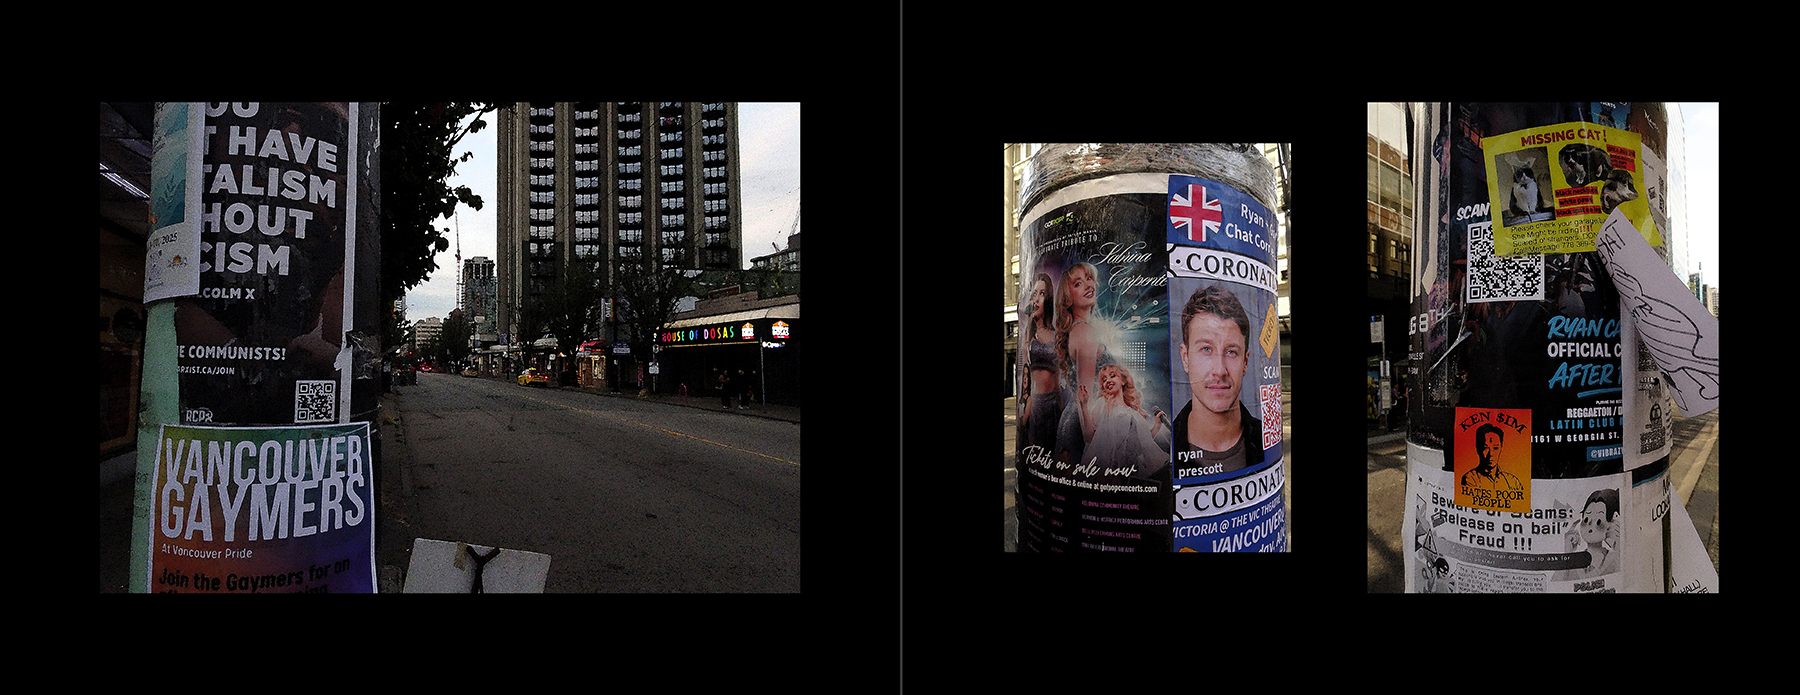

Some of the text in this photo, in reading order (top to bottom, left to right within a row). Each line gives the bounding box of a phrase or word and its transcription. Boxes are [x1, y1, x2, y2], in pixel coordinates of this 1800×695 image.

[1520, 133, 1575, 147] MISSING
[229, 126, 338, 173] HAVE
[1241, 203, 1264, 228] Ryan
[1456, 203, 1490, 221] SCAN
[1535, 221, 1555, 229] check
[1557, 219, 1572, 228] your
[1225, 222, 1254, 245] Chat
[1511, 233, 1526, 241] She
[1526, 229, 1546, 238] Might
[1512, 238, 1538, 247] Scared
[245, 288, 255, 300] X
[662, 331, 685, 342] HOUSE
[690, 329, 699, 341] OF
[703, 325, 735, 340] DOSAS
[1547, 315, 1604, 339] RYAN
[188, 345, 286, 360] COMMUNISTS!
[1547, 341, 1612, 358] OFFICIAL
[1547, 361, 1614, 389] AFTER
[1566, 406, 1612, 418] REGGAETON
[1459, 412, 1490, 432] KEN
[1550, 419, 1583, 430] LATIN
[1588, 417, 1615, 428] CLUB
[1554, 434, 1562, 443] W
[1566, 432, 1605, 442] GEORGIA
[1608, 431, 1620, 440] ST.
[166, 435, 363, 487] VANCOUVER
[1022, 444, 1138, 478] Tickets on sale now
[1178, 450, 1203, 463] ryan
[1178, 463, 1224, 480] prescott
[1461, 486, 1524, 500] HATES POOR
[161, 474, 365, 542] GAYMERS
[1472, 497, 1511, 509] PEOPLE
[1220, 519, 1230, 533] @
[1232, 513, 1248, 528] THE
[1249, 508, 1260, 523] VIC
[1502, 522, 1523, 534] on
[1459, 529, 1532, 551] Fraud !!!
[162, 543, 253, 559] At Vancouver Pride
[159, 569, 189, 587] Join
[193, 573, 220, 591] the
[226, 570, 304, 593] Gaymers
[309, 565, 331, 582] for
[334, 558, 351, 574] an
